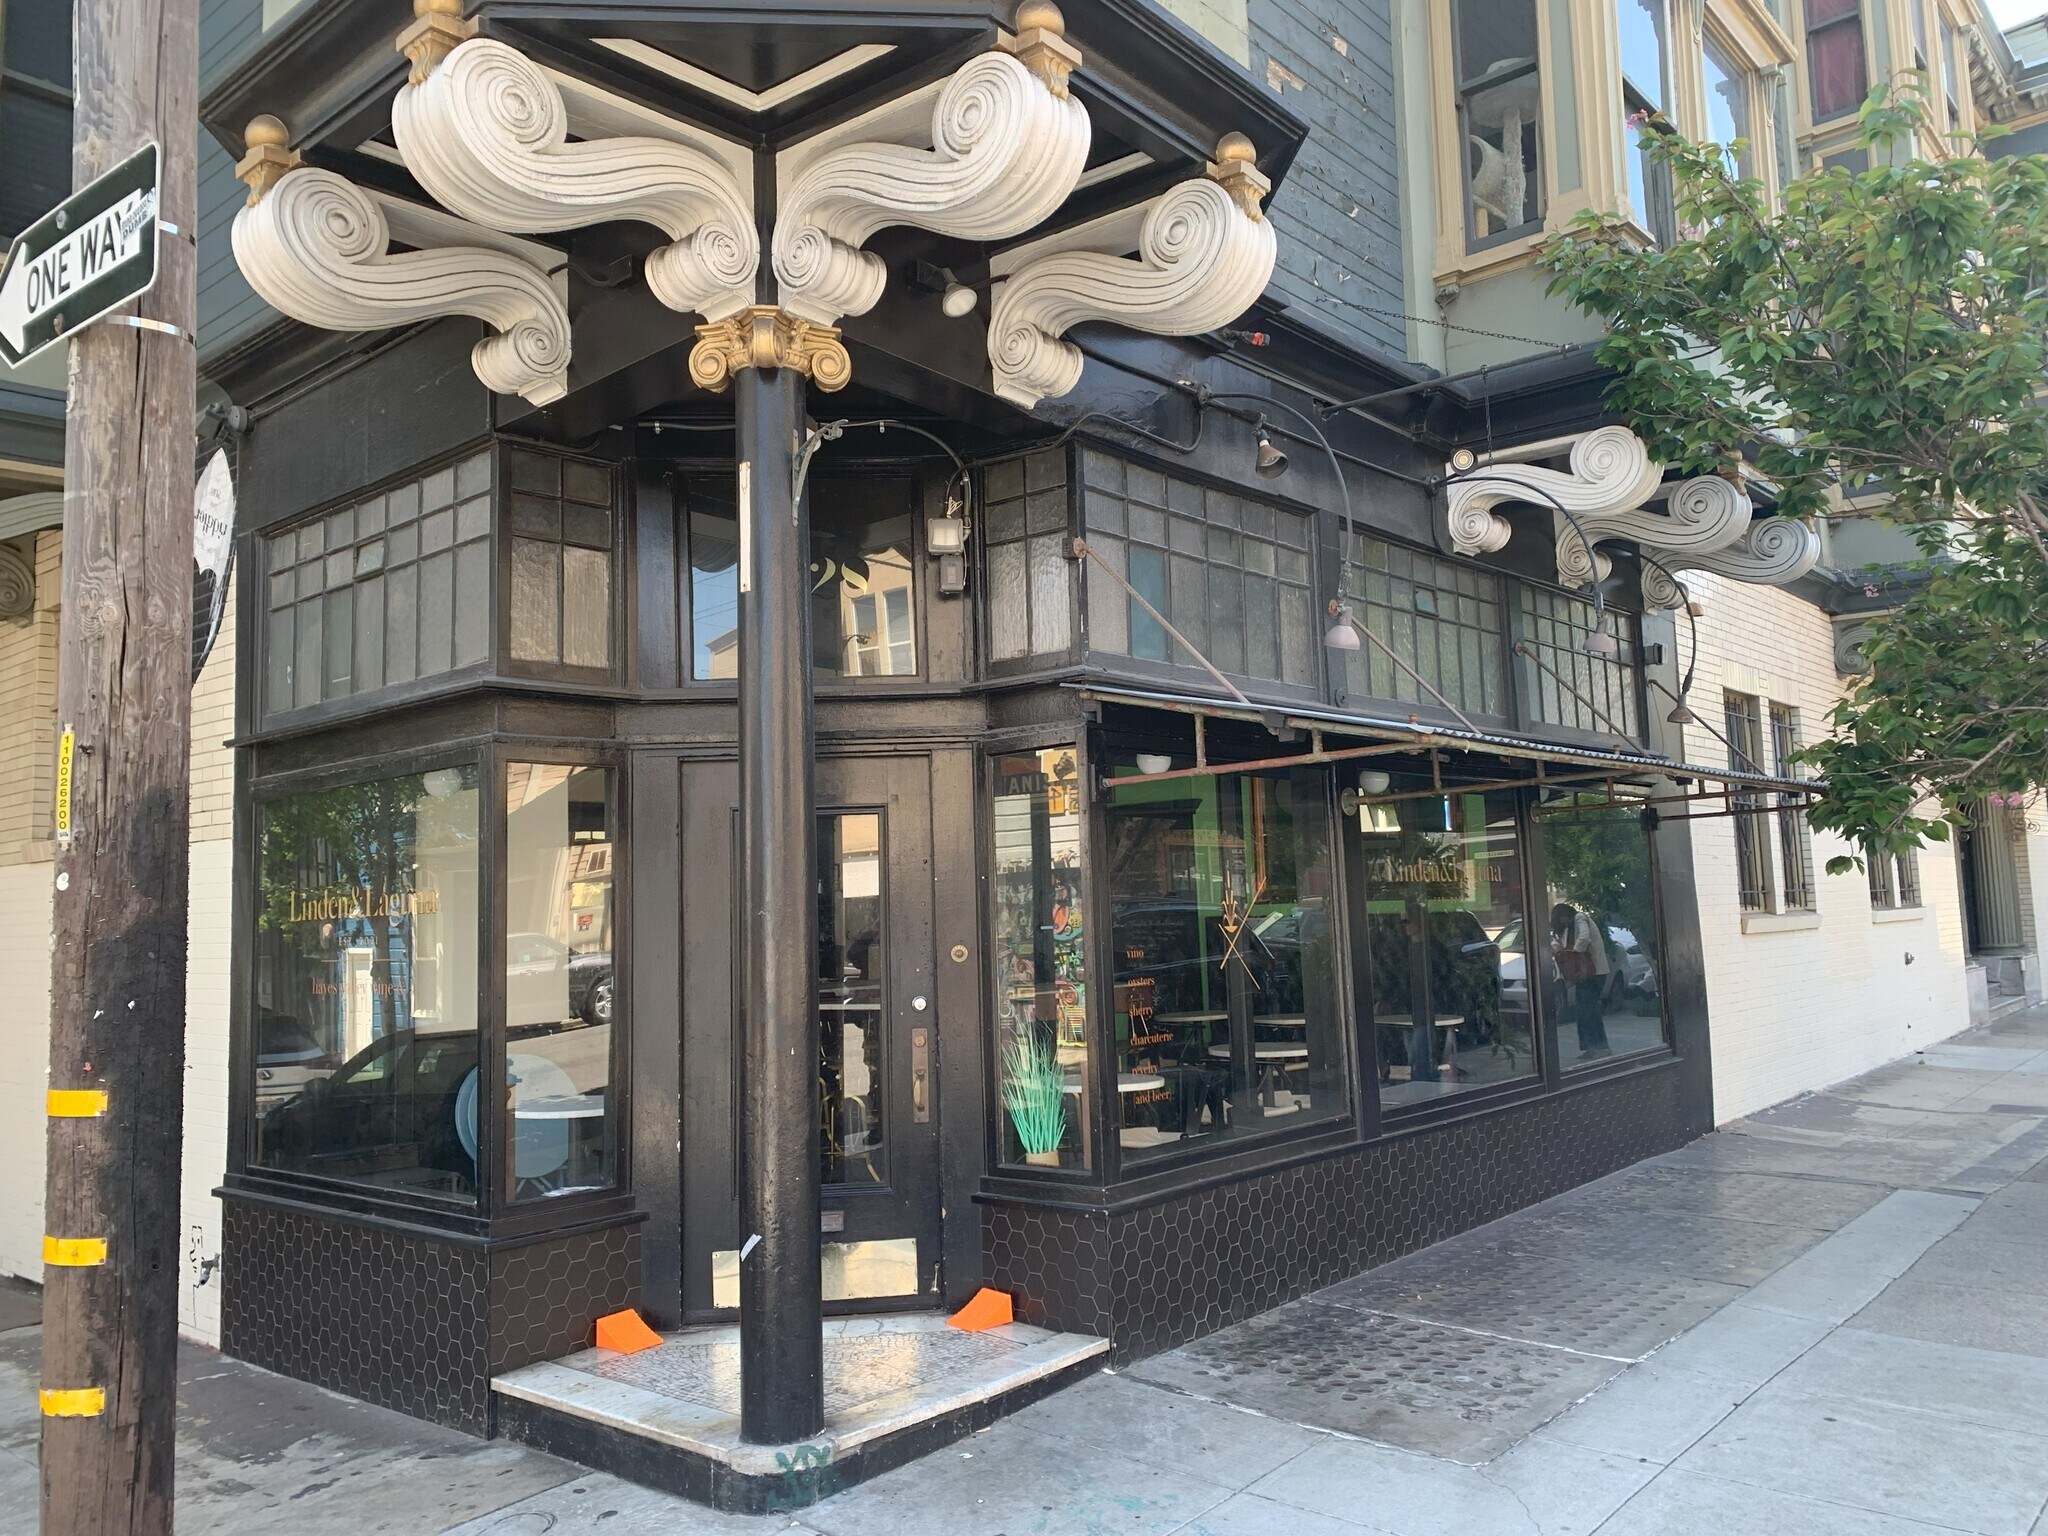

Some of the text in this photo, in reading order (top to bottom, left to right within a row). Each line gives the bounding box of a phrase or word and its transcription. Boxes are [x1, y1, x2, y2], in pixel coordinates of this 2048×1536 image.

[27, 242, 71, 314] ONE
[58, 736, 69, 829] 110026200
[1126, 949, 1145, 959] vino
[311, 977, 337, 996] hayes
[1127, 976, 1155, 987] oysters
[1128, 1005, 1154, 1018] sherry
[1130, 1030, 1174, 1046] charcuterie
[1132, 1063, 1159, 1077] revelry
